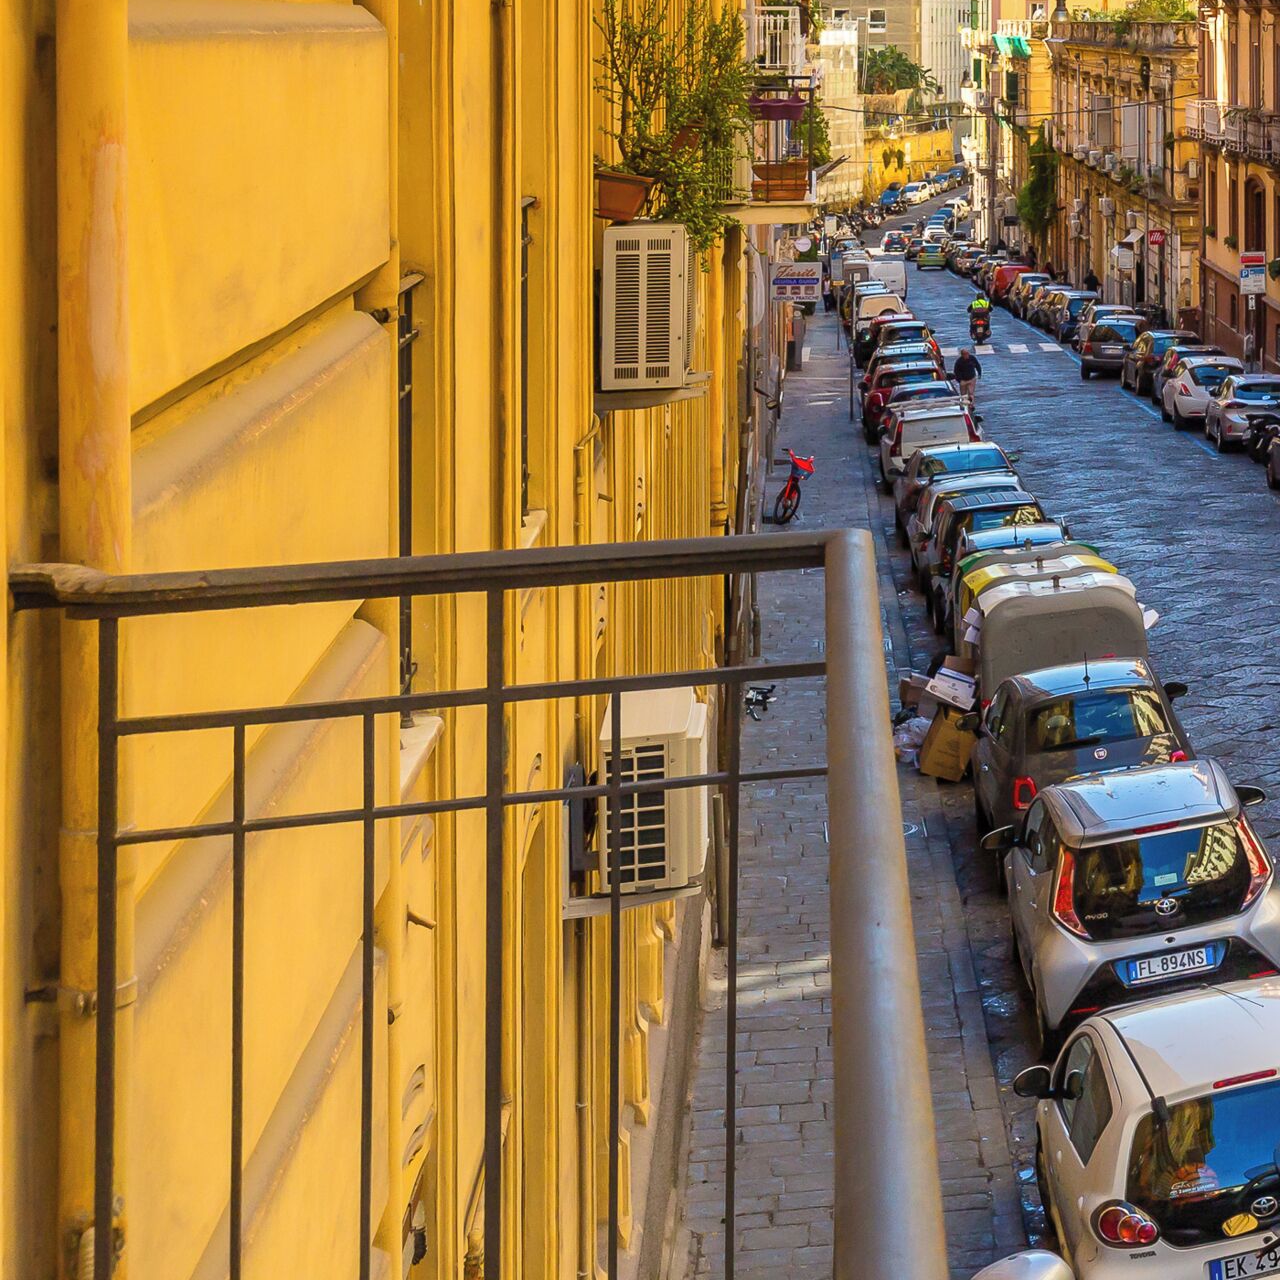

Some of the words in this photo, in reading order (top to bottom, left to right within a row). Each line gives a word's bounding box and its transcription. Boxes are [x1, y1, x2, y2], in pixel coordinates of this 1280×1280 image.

[1138, 960, 1156, 977] FL
[1160, 950, 1205, 972] 894NS
[1224, 1257, 1248, 1280] EK
